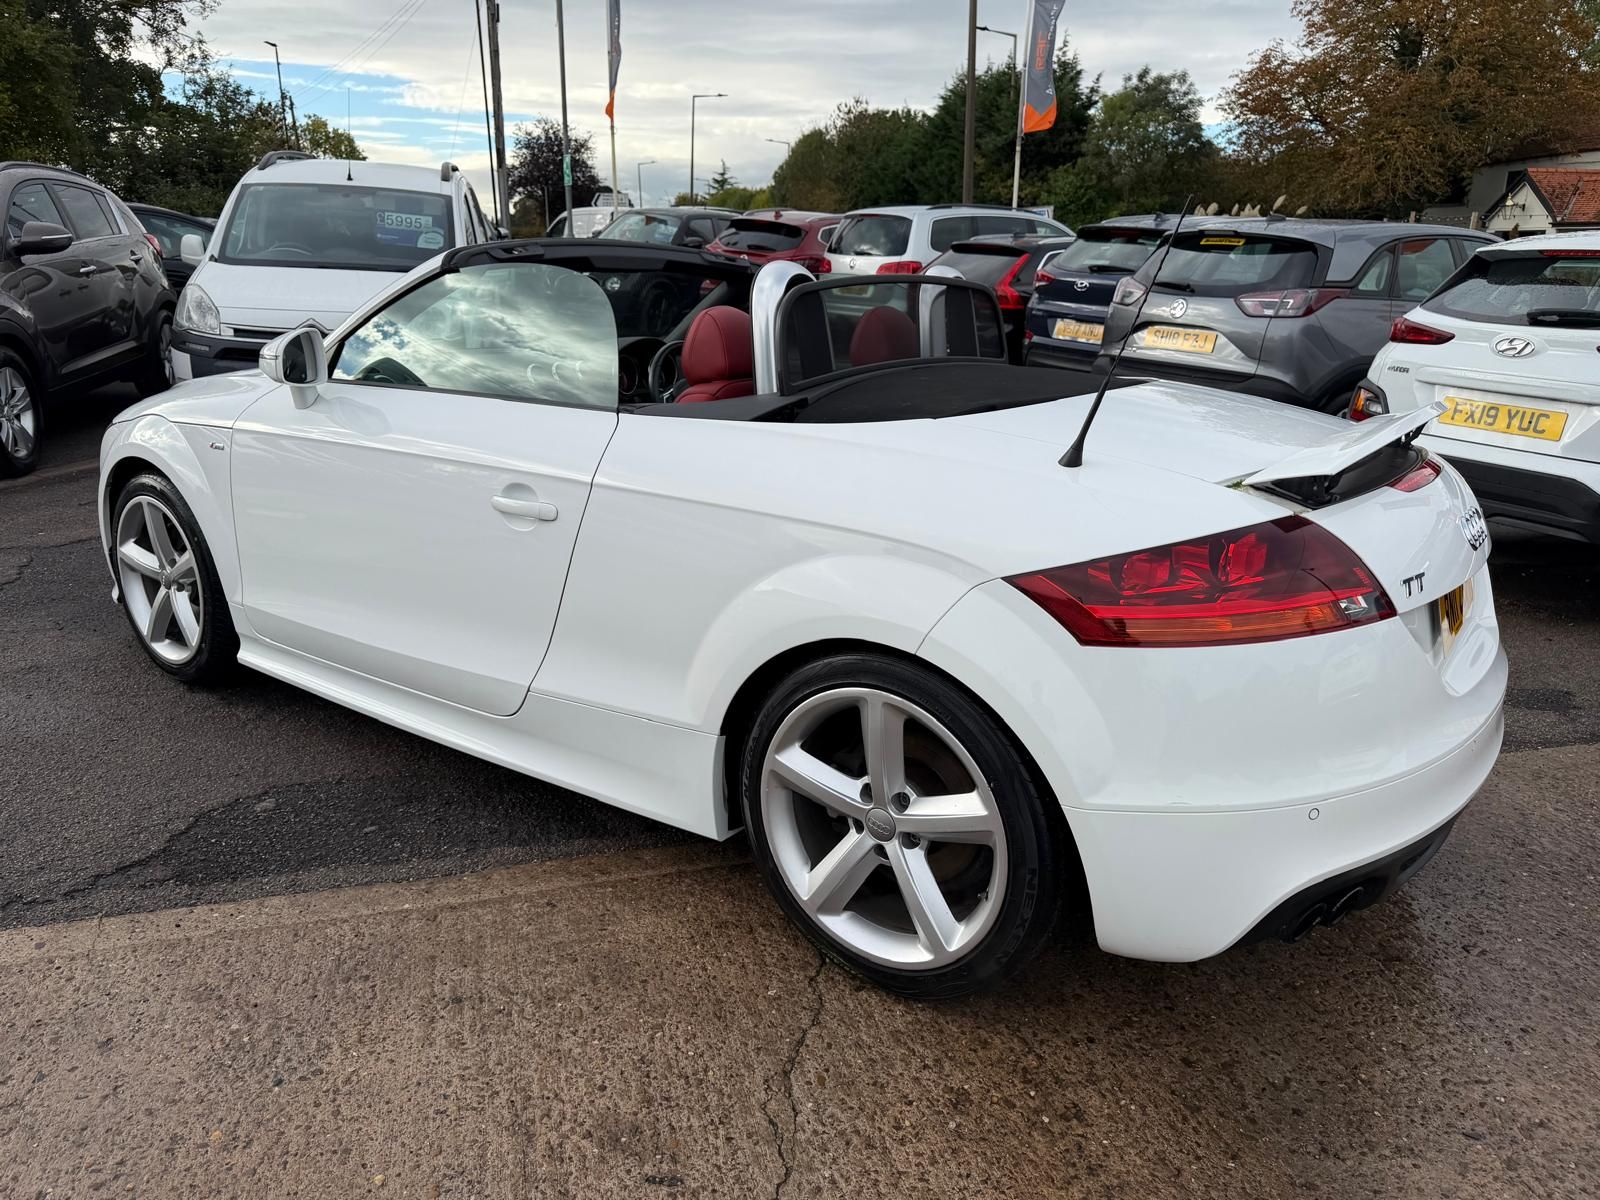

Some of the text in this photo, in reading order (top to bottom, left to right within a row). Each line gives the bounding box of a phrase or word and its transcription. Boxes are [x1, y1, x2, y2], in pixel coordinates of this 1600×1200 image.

[1450, 401, 1551, 435] FX19 YUC
[1400, 572, 1425, 599] TT
